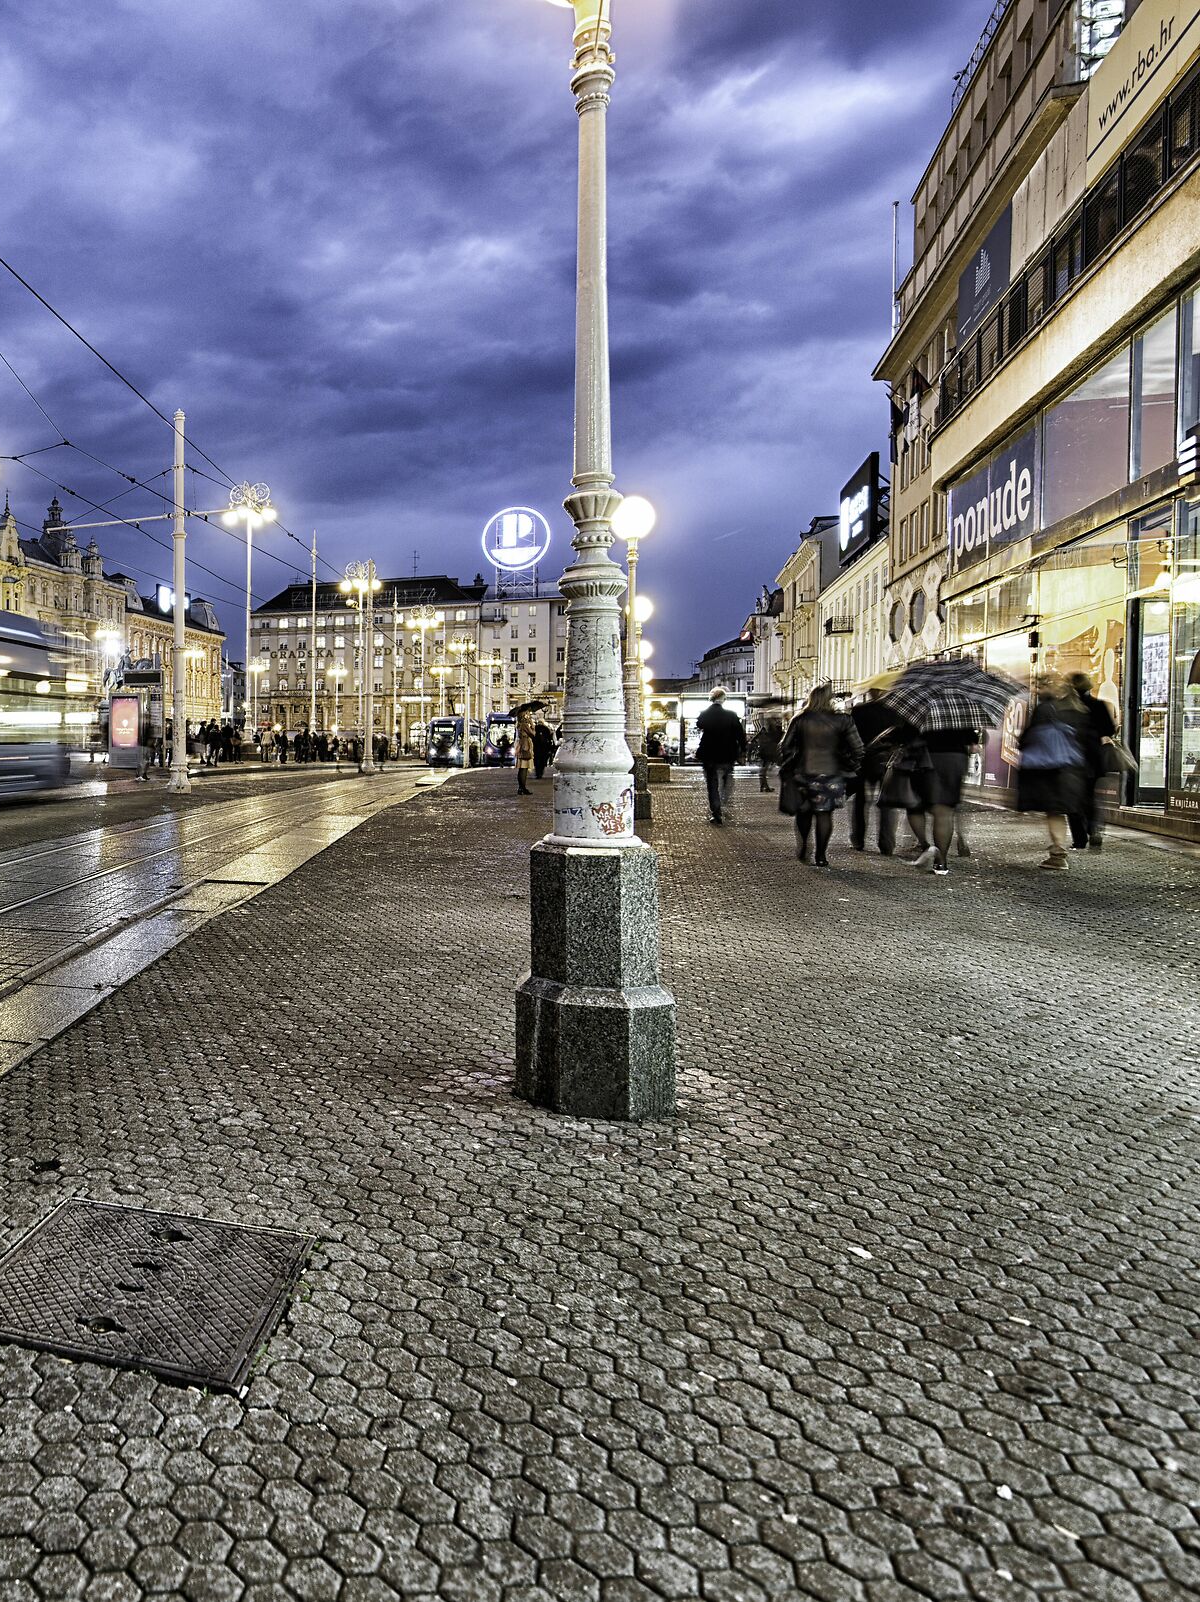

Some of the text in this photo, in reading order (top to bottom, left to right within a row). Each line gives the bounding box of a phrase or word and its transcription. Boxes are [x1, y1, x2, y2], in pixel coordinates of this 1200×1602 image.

[1098, 16, 1175, 130] www.rba.hr
[953, 459, 1031, 573] ponude
[270, 650, 334, 659] GRADSKA
[1175, 797, 1199, 810] KNJIŽARA
